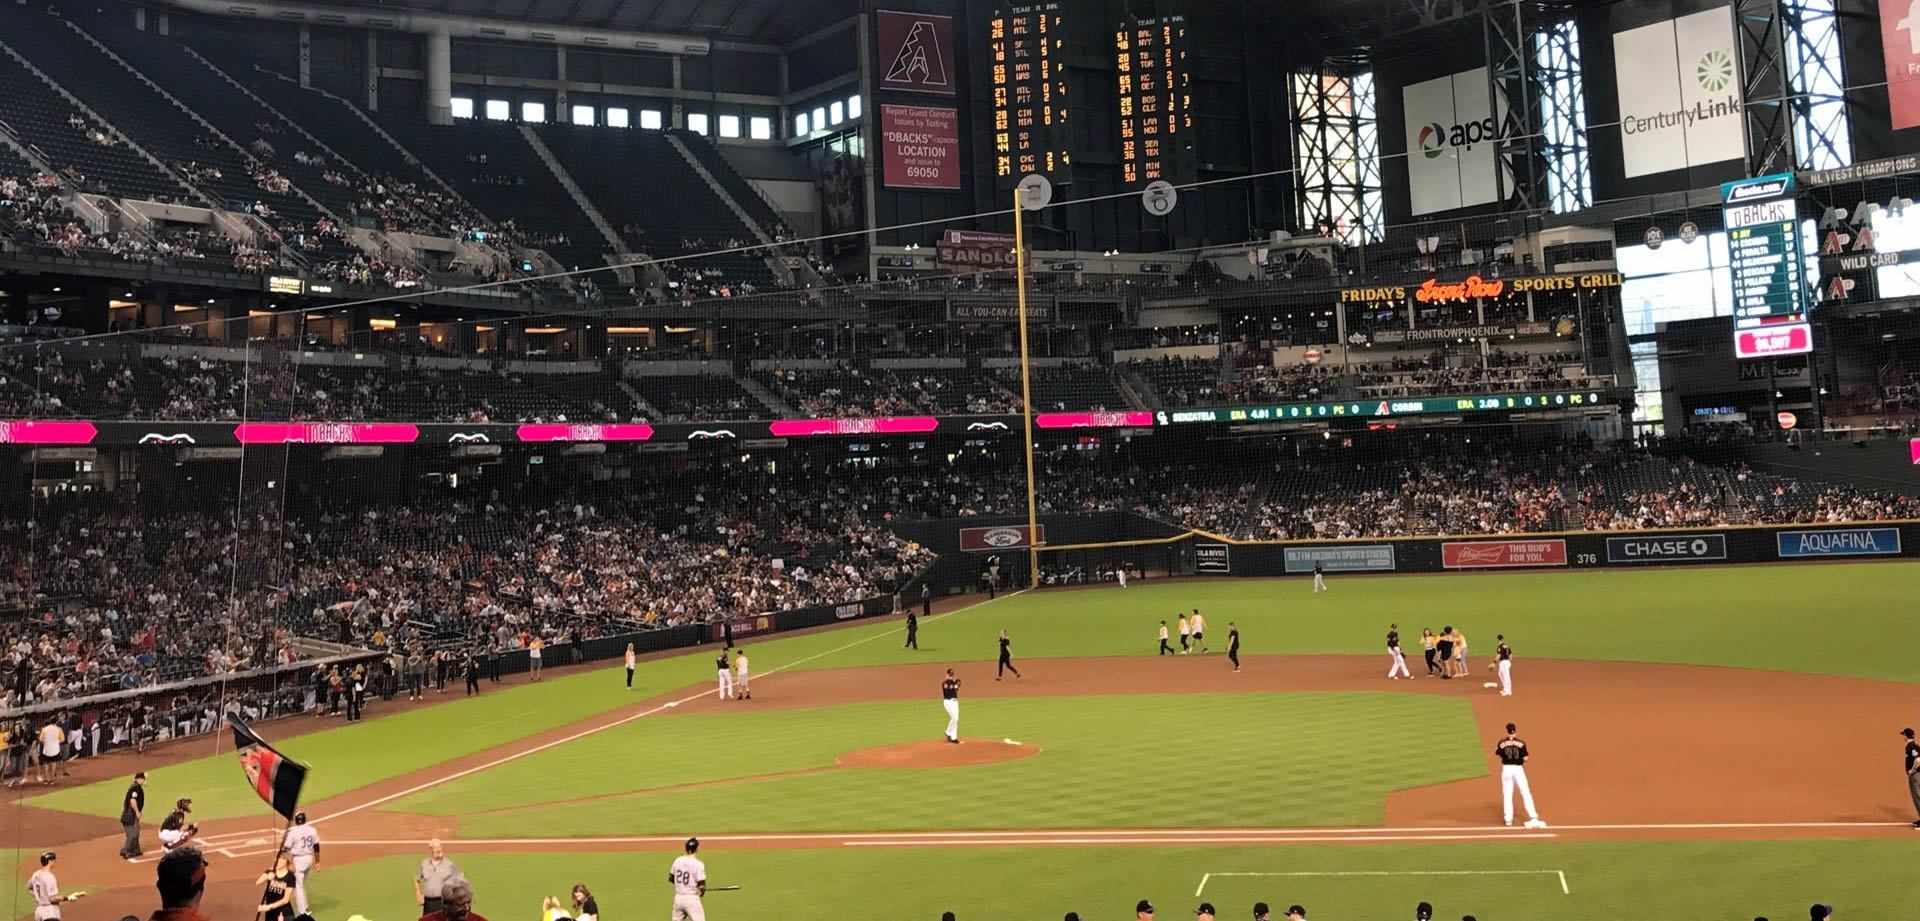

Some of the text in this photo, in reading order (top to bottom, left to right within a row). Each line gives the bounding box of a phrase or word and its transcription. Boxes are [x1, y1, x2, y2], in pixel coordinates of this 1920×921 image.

[1012, 6, 1031, 14] TEAM
[1014, 17, 1026, 26] PHI
[1137, 19, 1156, 27] TEAM
[1014, 26, 1028, 35] ATL
[1015, 40, 1024, 49] SF
[1015, 49, 1029, 57] STL
[1139, 52, 1149, 60] TB
[1140, 74, 1150, 82] KC
[1016, 86, 1031, 94] MIL
[1017, 95, 1031, 103] PIT
[886, 107, 955, 120] Report Guest Conduct
[1018, 109, 1032, 117] CIN
[1142, 104, 1157, 113] CLE
[1623, 95, 1740, 135] CenturyLink
[916, 119, 924, 129] by
[926, 119, 949, 129] Texting
[1018, 118, 1033, 126] MIA
[884, 131, 933, 144] "DBACKS"
[1449, 117, 1495, 151] aps
[1019, 141, 1029, 150] LA
[1145, 140, 1159, 148] SEA
[898, 145, 946, 157] LOCATION
[1145, 148, 1159, 157] TEX
[934, 159, 941, 167] to
[1146, 162, 1160, 170] MIN
[907, 166, 939, 178] 69050
[1810, 157, 1917, 185] NL WEST CHAMPIONS
[942, 247, 1020, 266] SANDLO
[1840, 252, 1898, 270] WILD CARD
[1341, 287, 1406, 302] FRIDAY'S
[1513, 276, 1575, 292] SPORTS
[956, 306, 1020, 319] ALL-YOU-CAN-EA
[1406, 325, 1515, 341] FRONTROWPHOENIX.com
[1457, 399, 1474, 409] ERA
[1524, 396, 1532, 406] 0
[1556, 395, 1563, 404] 0
[1570, 394, 1582, 404] PC
[1590, 393, 1598, 403] 0
[1230, 410, 1247, 420] ERA
[1291, 407, 1299, 417] 0
[1319, 406, 1326, 415] 0
[1333, 405, 1345, 415] PC
[1351, 404, 1359, 414] 0
[1799, 531, 1876, 553] AQUAFINA
[1508, 543, 1552, 553] THIS BUD'S
[1624, 542, 1688, 556] CHASE
[1509, 552, 1545, 563] FOR YOU.
[1576, 554, 1597, 565] 376
[301, 834, 314, 850] 39
[676, 869, 690, 885] 28
